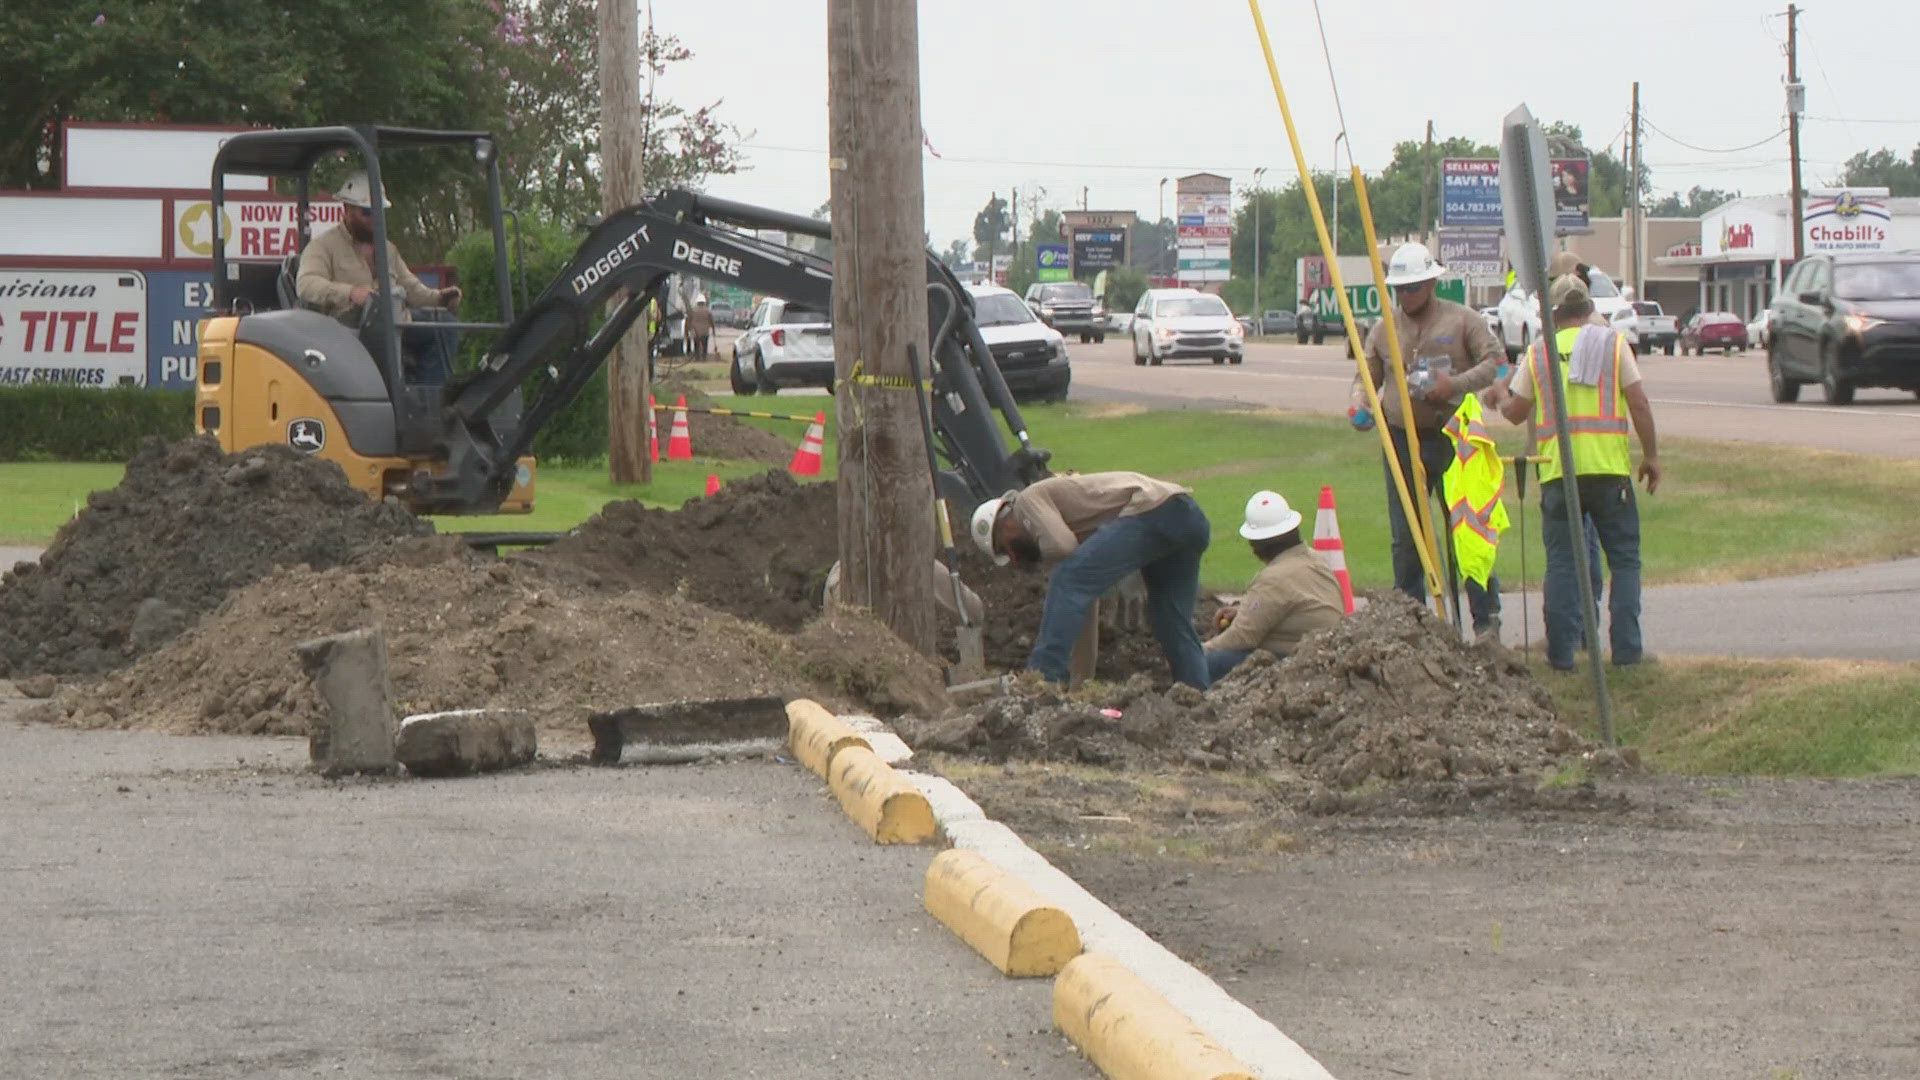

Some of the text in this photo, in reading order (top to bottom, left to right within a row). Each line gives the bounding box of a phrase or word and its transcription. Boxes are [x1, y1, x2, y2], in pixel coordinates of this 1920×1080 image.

[1446, 162, 1488, 171] SELLING
[1446, 175, 1499, 187] SAVE TH
[241, 205, 282, 222] NOW
[241, 227, 299, 256] REA
[1810, 225, 1885, 241] Chabill's
[572, 224, 651, 295] DOGGETT
[672, 239, 743, 277] DEERE
[184, 281, 215, 307] EX
[1320, 286, 1396, 316] MLO
[20, 311, 139, 353] TITLE
[33, 367, 104, 385] SERVICES
[161, 356, 198, 382] PU
